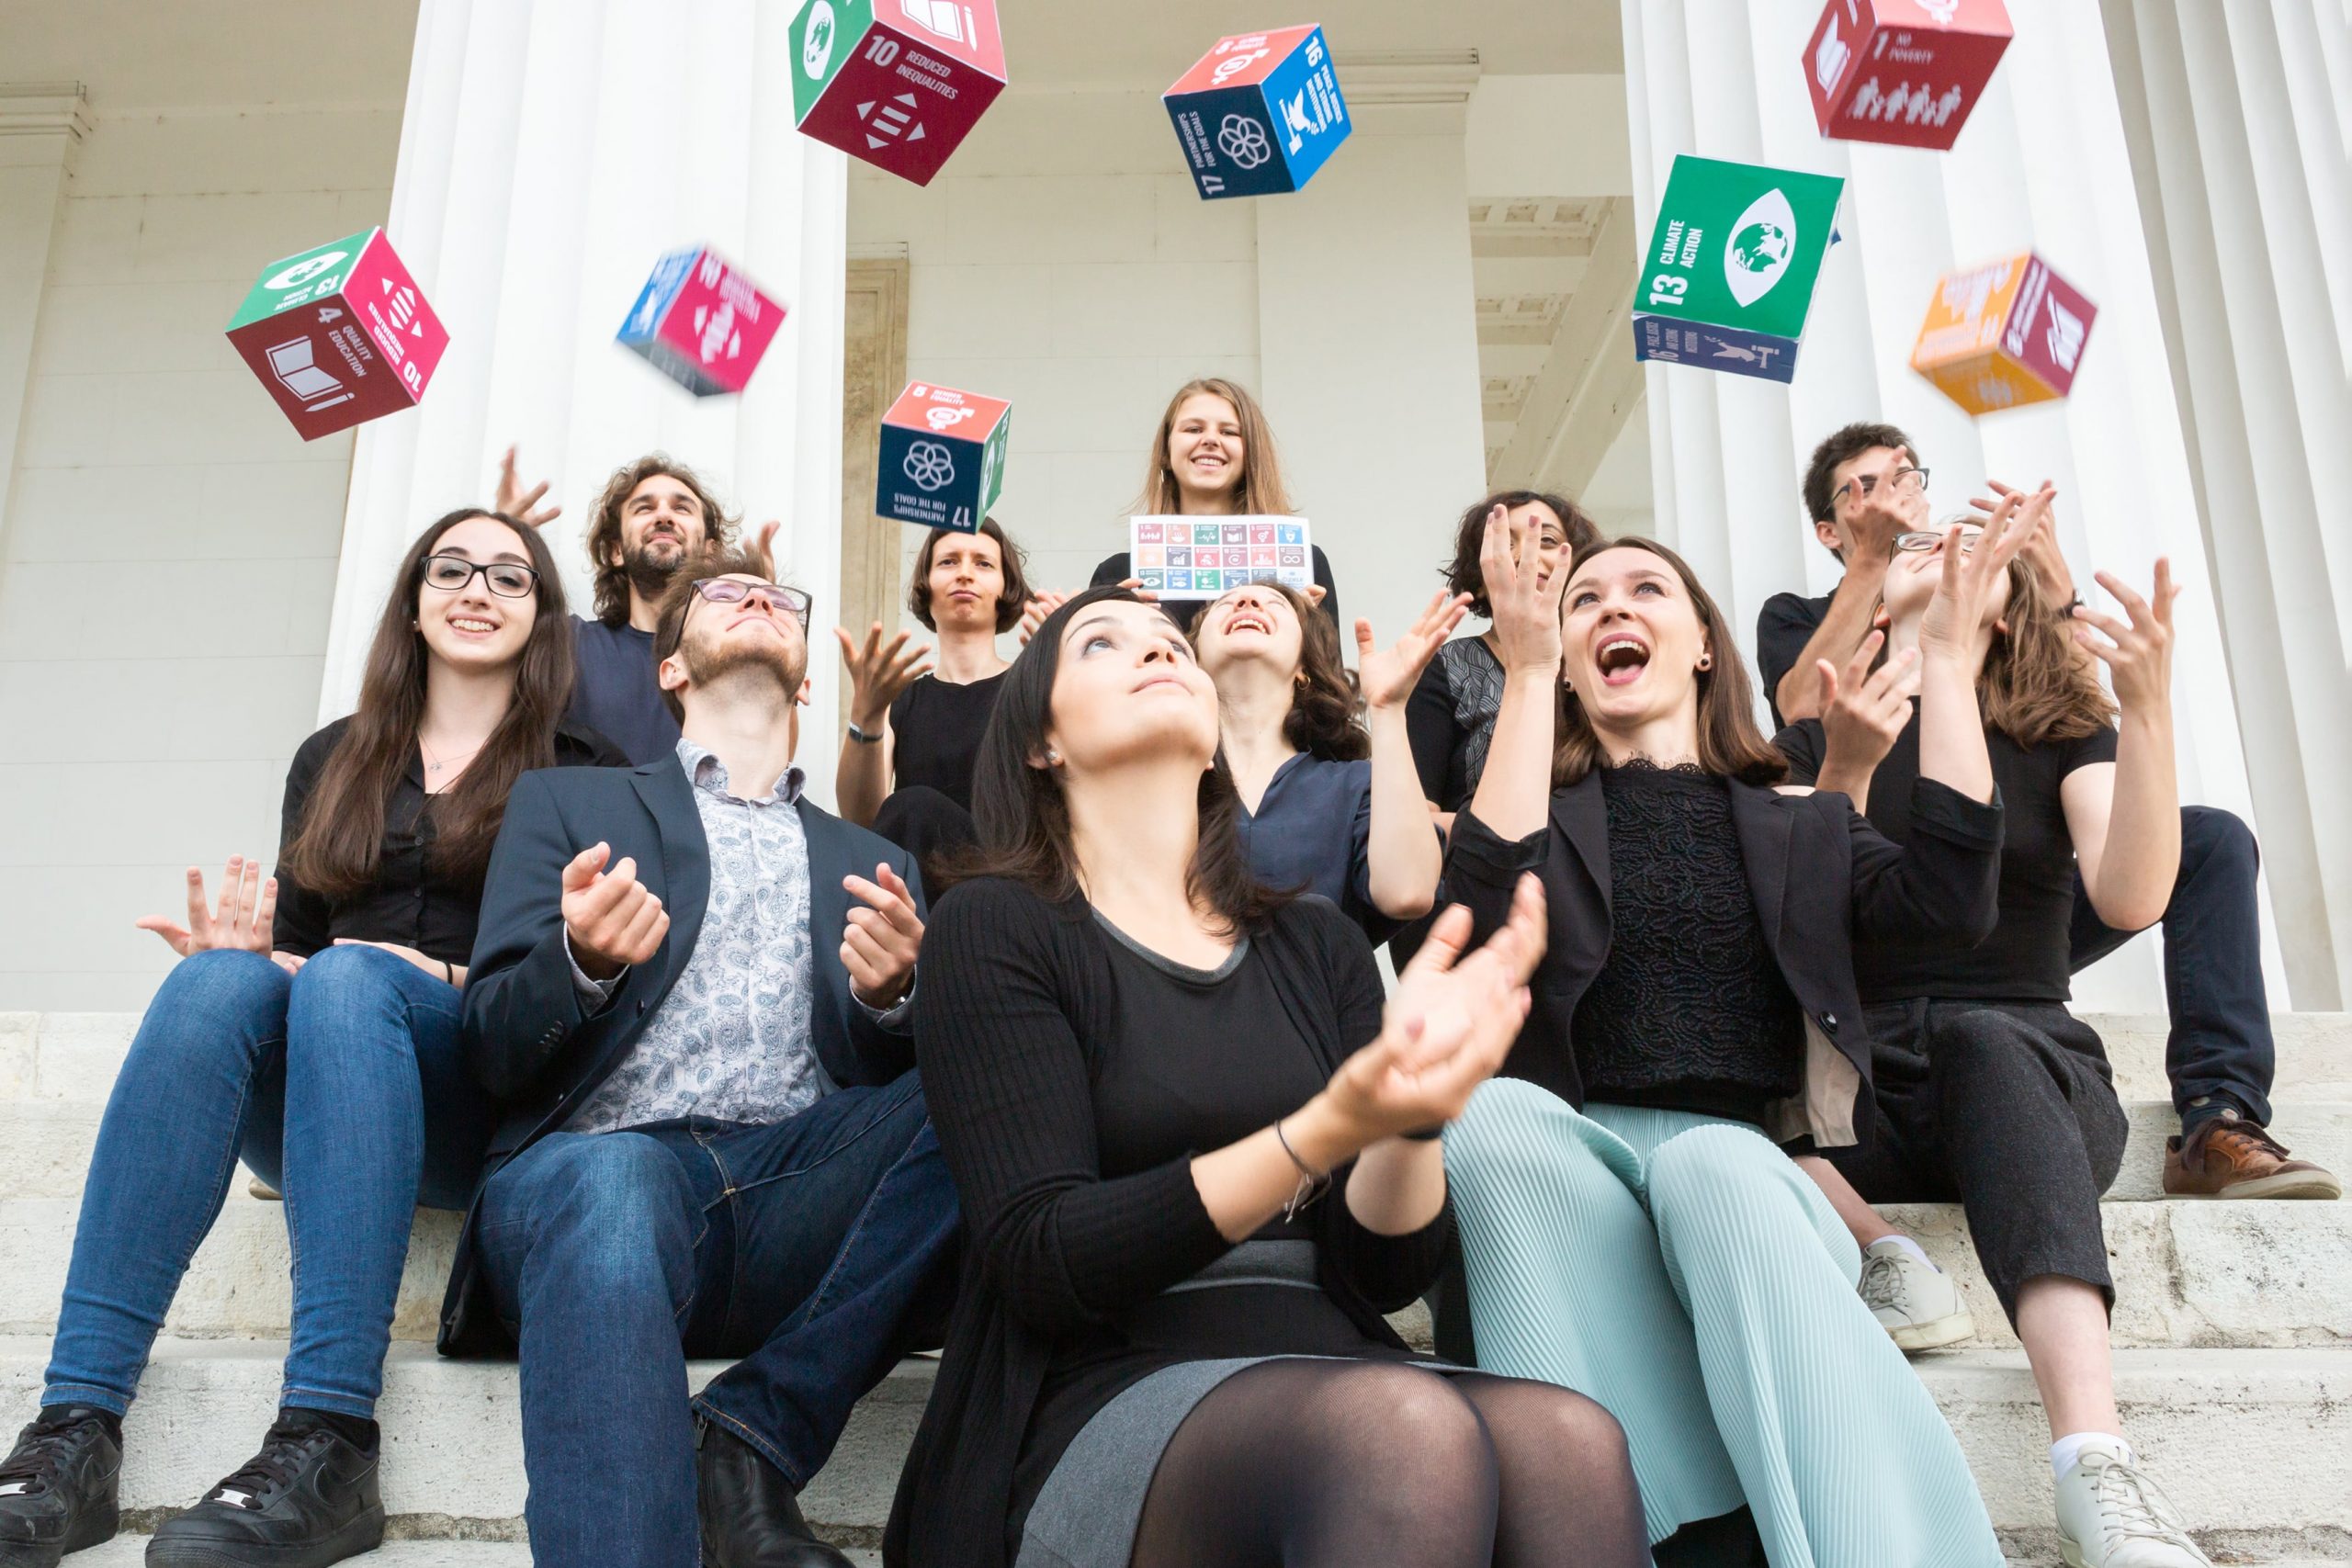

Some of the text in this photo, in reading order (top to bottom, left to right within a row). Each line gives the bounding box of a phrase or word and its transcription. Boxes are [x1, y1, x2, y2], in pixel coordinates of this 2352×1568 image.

[865, 35, 899, 67] 10
[906, 50, 951, 78] REDUCED
[1305, 36, 1323, 67] 16
[896, 63, 958, 100] INEQUALITIES
[1306, 78, 1328, 133] INSTITUTIONS
[1313, 72, 1333, 124] AND STRONG
[1178, 112, 1204, 169] PARTNERSHIPS
[1189, 111, 1216, 167] FOR THE GOALS
[1201, 175, 1225, 195] 17
[1659, 219, 1685, 265] CLIMATE
[1679, 228, 1703, 268] ACTION
[282, 285, 313, 302] ACTION
[315, 274, 340, 297] 13
[1649, 274, 1688, 306] 13
[273, 294, 309, 311] CLIMATE
[318, 307, 343, 323] 4
[342, 325, 373, 361] QUALITY
[368, 301, 405, 357] INEQUALITIES
[328, 330, 368, 378] EDUCATION
[373, 325, 401, 366] REDUCED
[1647, 349, 1679, 361] 16
[403, 360, 423, 393] 10
[893, 503, 945, 523] PARTNERSHIPS
[894, 492, 946, 513] FOR THE GOALS
[952, 506, 971, 527] 17
